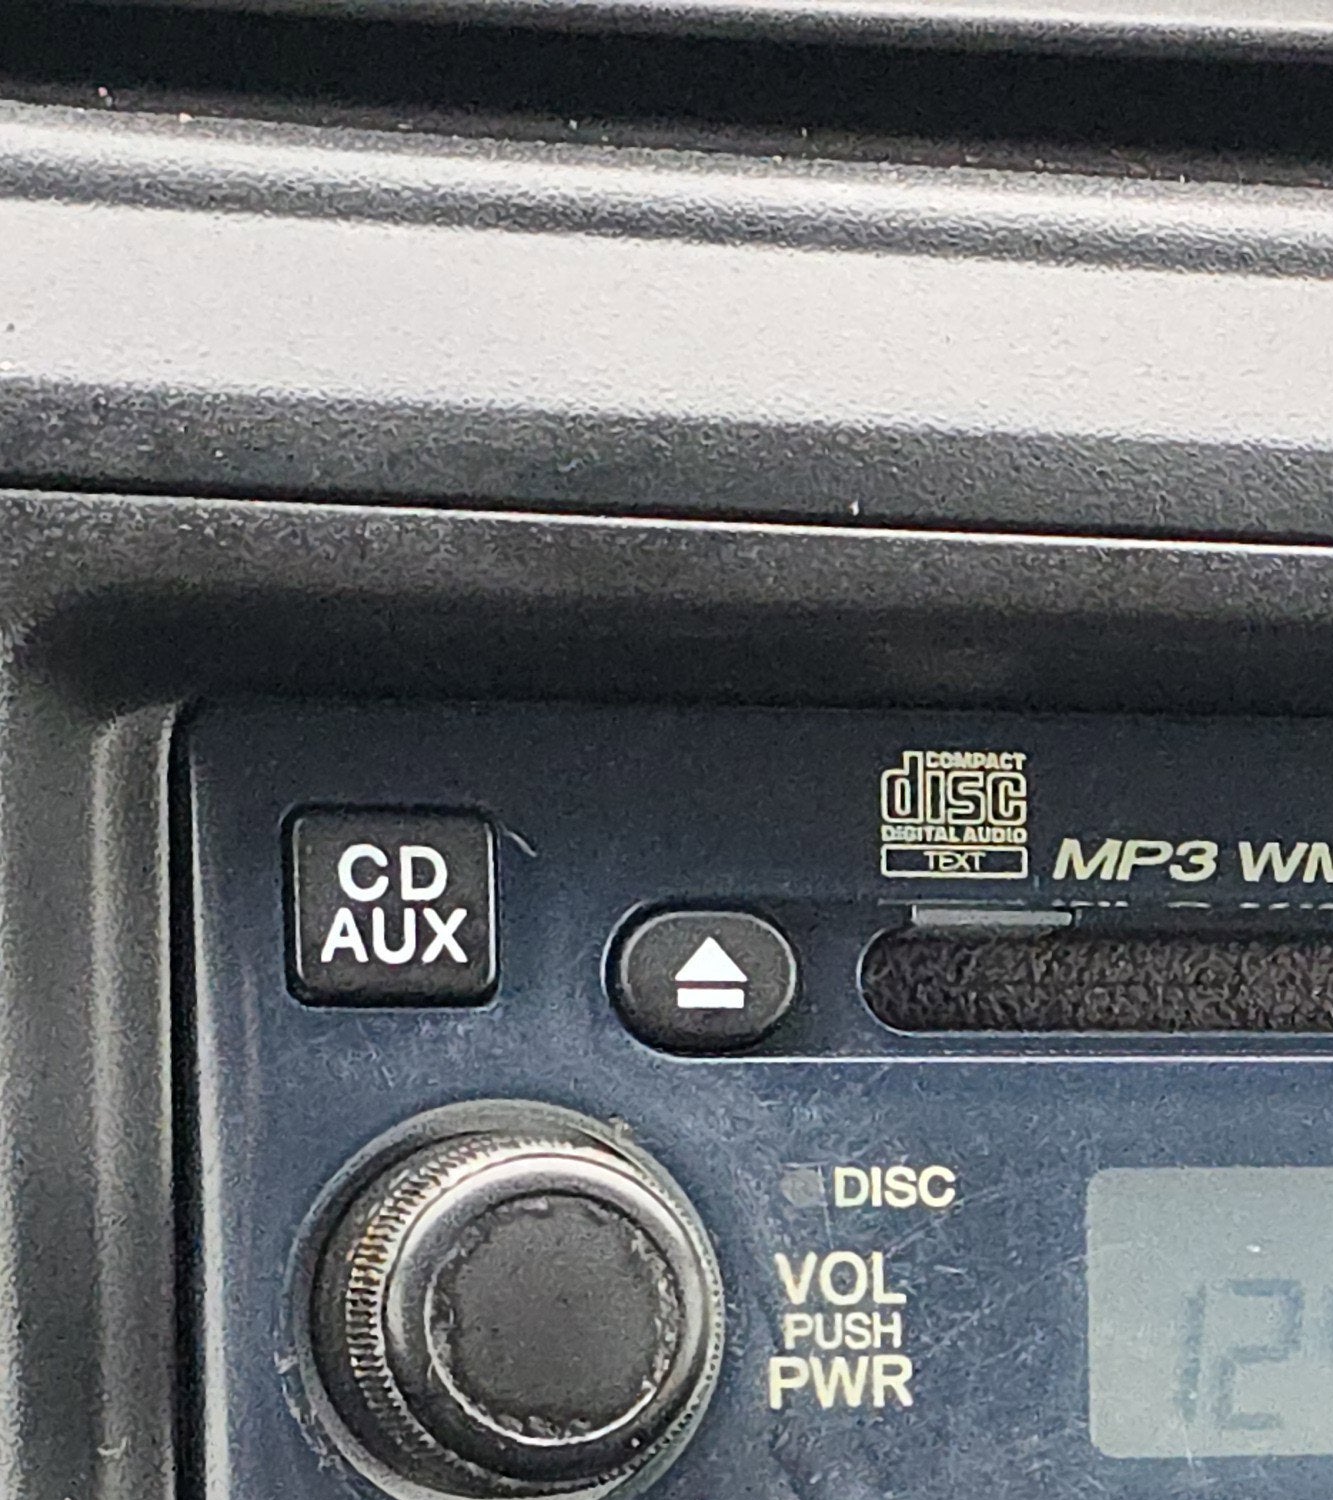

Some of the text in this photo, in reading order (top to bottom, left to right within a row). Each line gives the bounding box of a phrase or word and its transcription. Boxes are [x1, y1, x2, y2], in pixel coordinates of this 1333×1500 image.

[925, 750, 1027, 771] COMPACT
[881, 824, 1028, 844] DIGITAL AUDIO
[337, 843, 448, 902] CD
[923, 850, 986, 872] TEXT
[1052, 837, 1218, 882] MP3
[320, 906, 468, 965] AUX
[834, 1165, 956, 1208] DISC
[774, 1251, 907, 1306] VOL
[784, 1311, 902, 1350] PUSH
[768, 1354, 913, 1410] PWR
